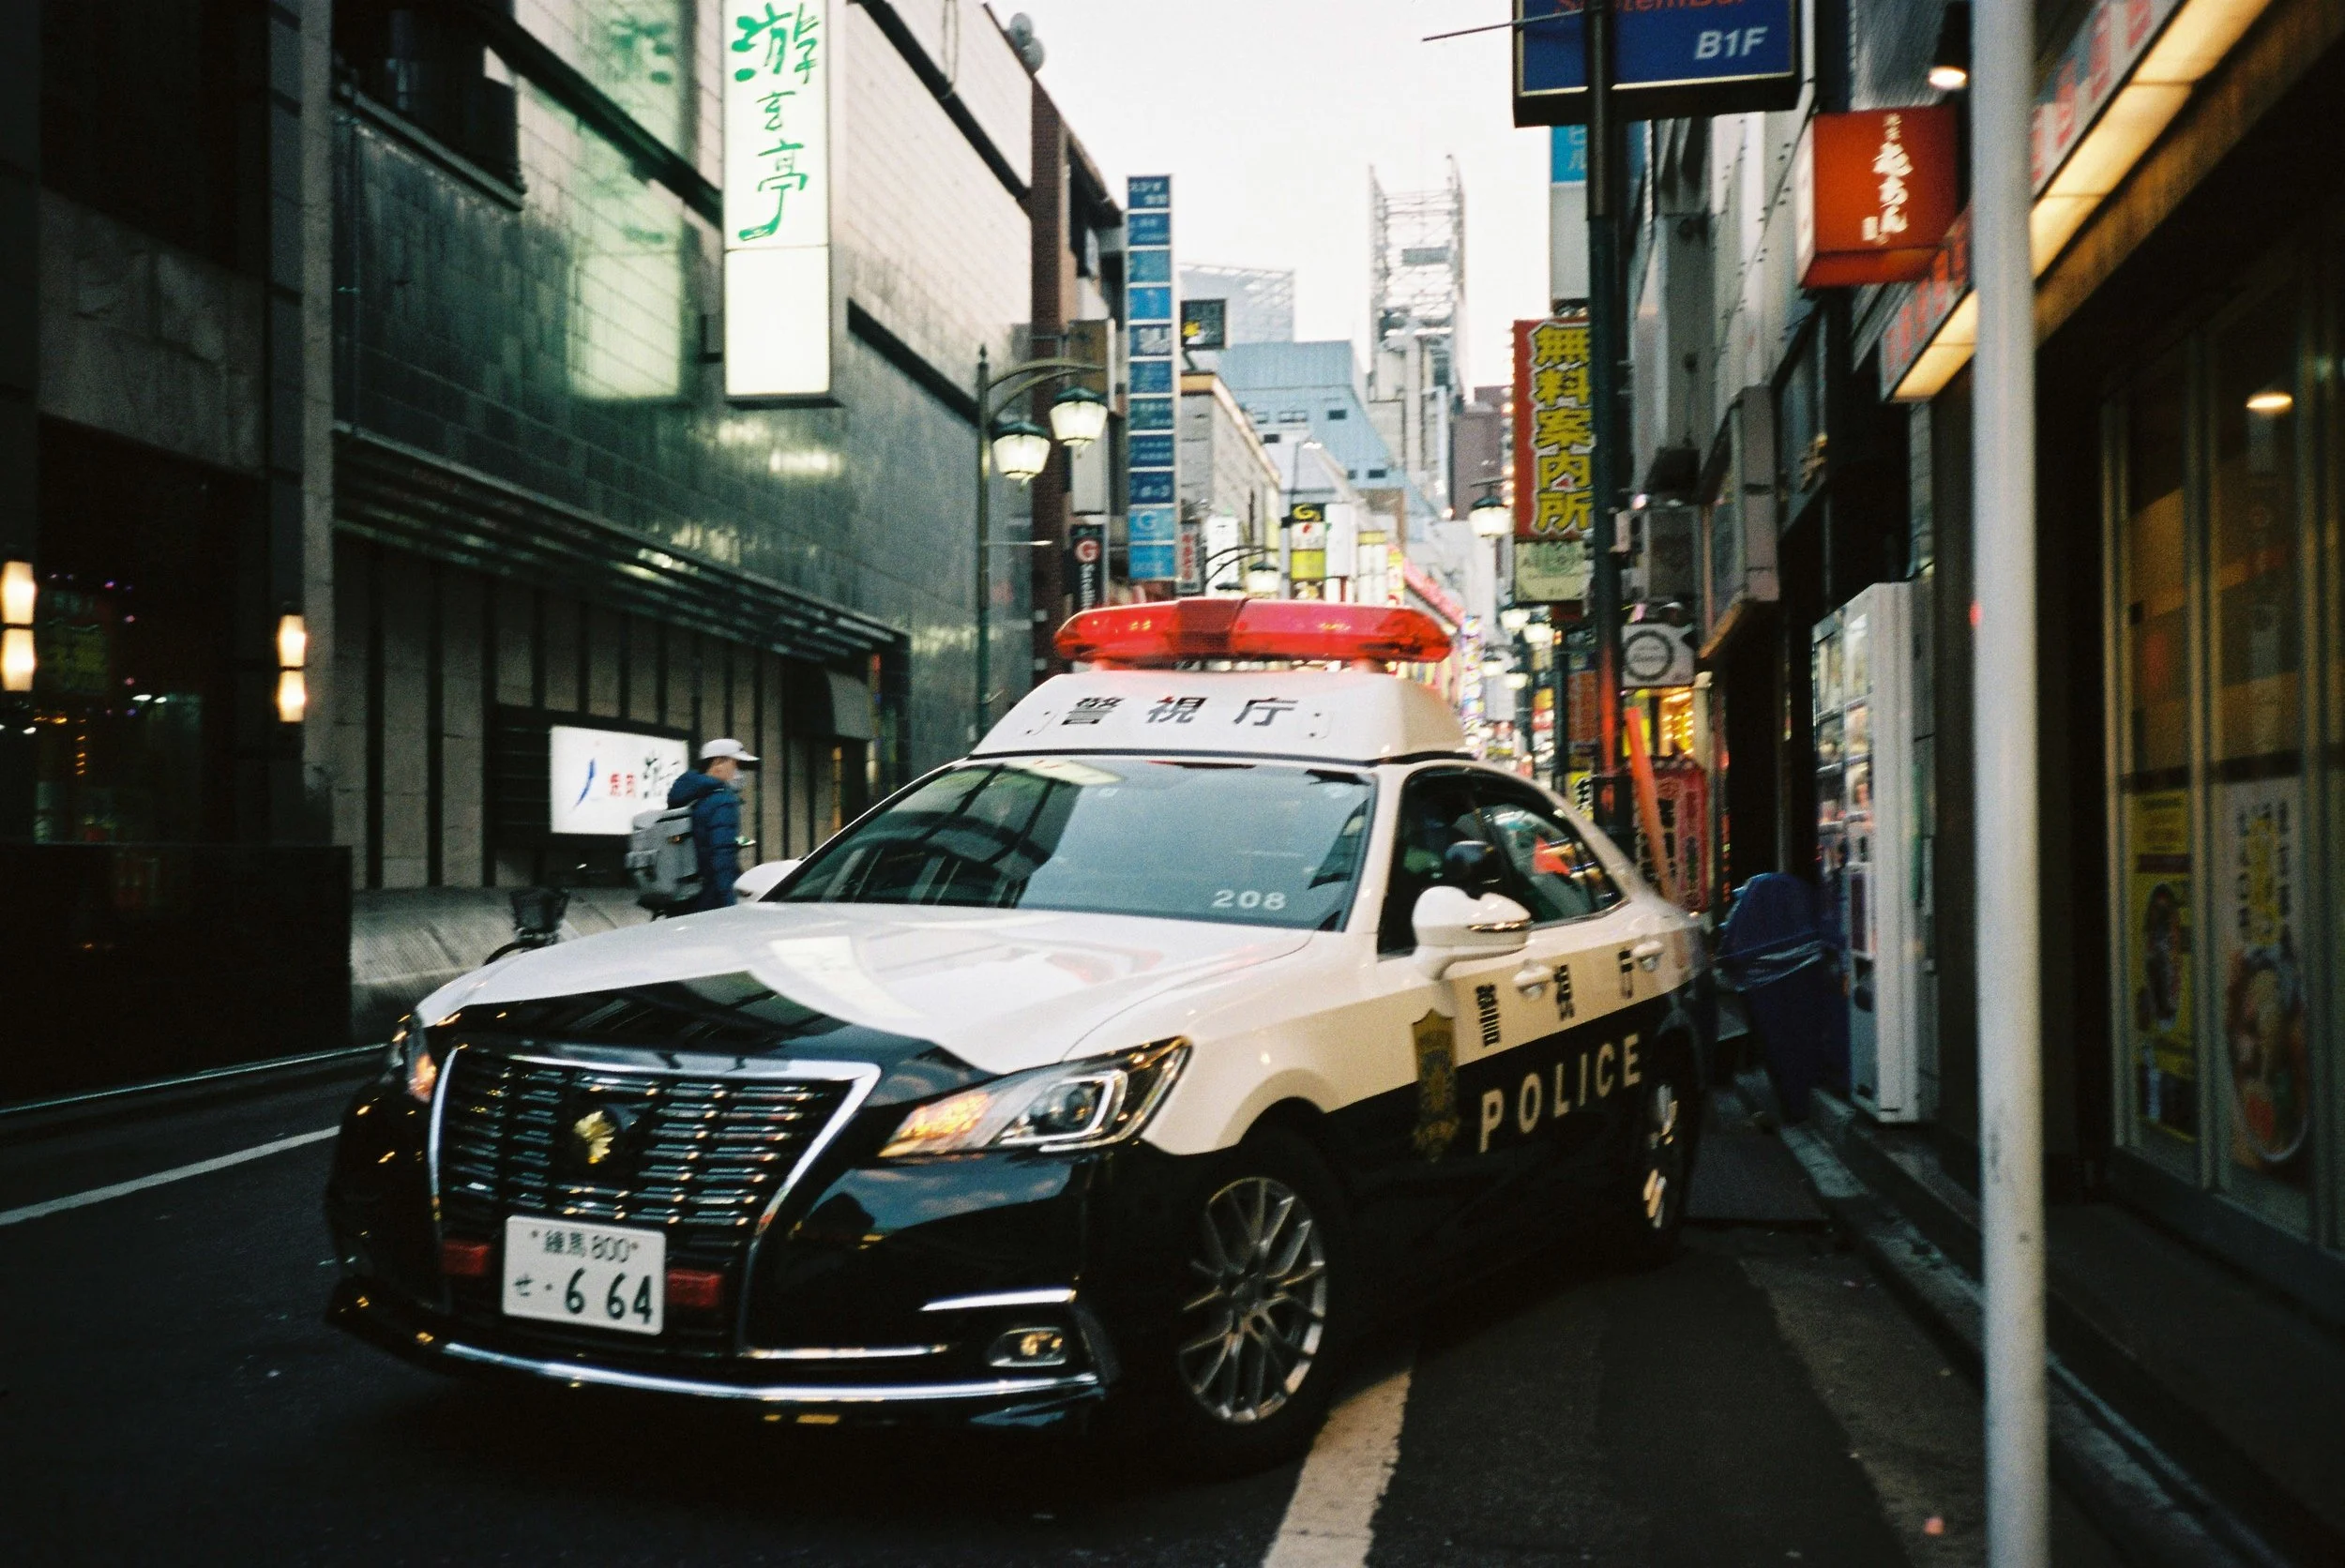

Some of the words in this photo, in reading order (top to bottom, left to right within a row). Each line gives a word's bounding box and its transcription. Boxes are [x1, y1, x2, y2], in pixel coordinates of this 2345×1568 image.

[1694, 26, 1768, 60] B1F
[1534, 326, 1593, 532] 無料案内所
[1061, 696, 1298, 727] 警視庁
[1211, 889, 1287, 912] 208
[1478, 1033, 1642, 1154] POLICE
